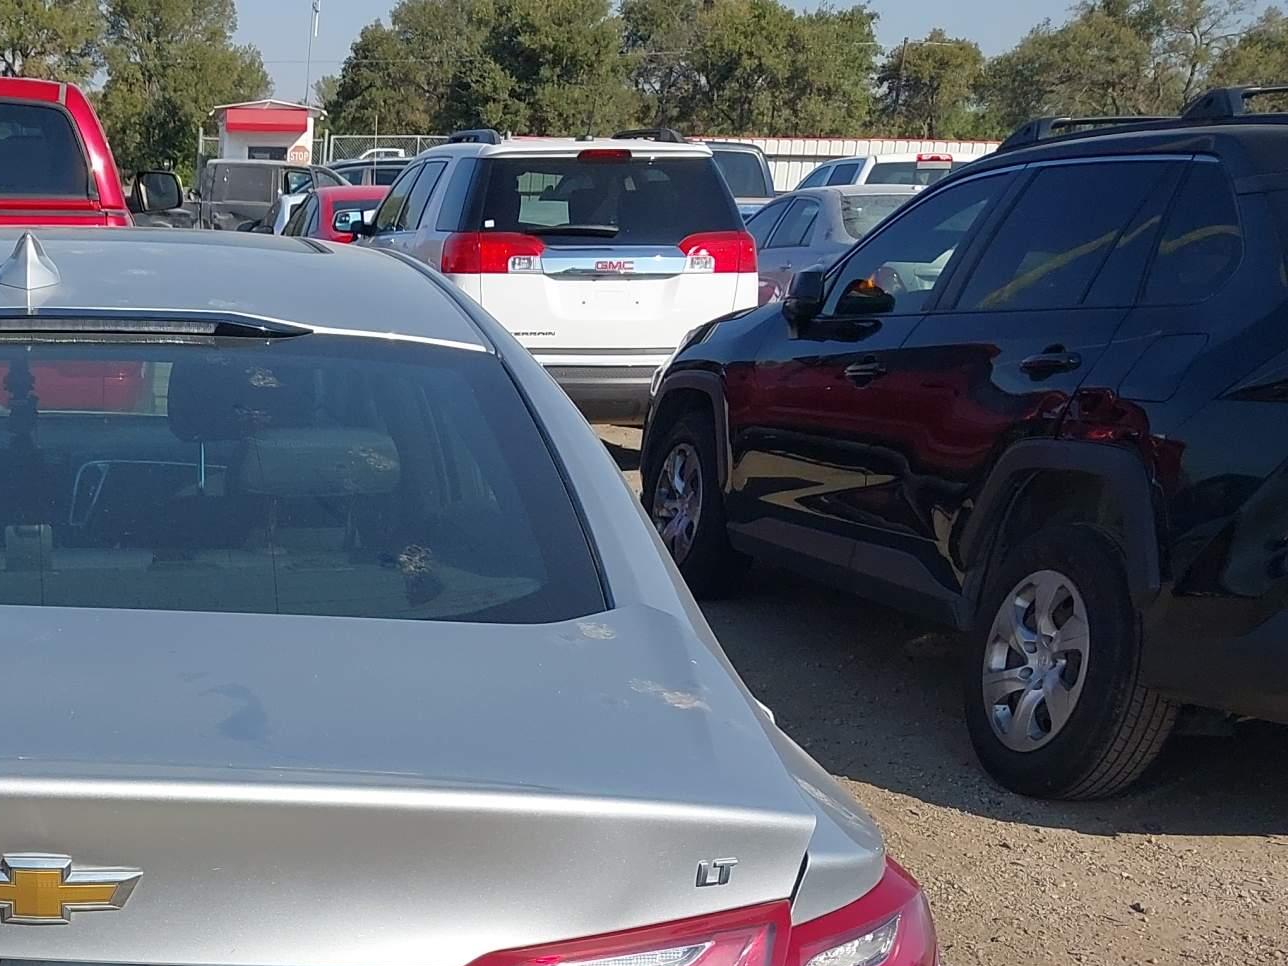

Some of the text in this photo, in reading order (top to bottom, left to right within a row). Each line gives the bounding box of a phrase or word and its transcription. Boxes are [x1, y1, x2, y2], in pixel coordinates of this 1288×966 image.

[290, 151, 309, 161] STOP
[595, 260, 634, 270] GMC
[695, 857, 738, 887] LT
